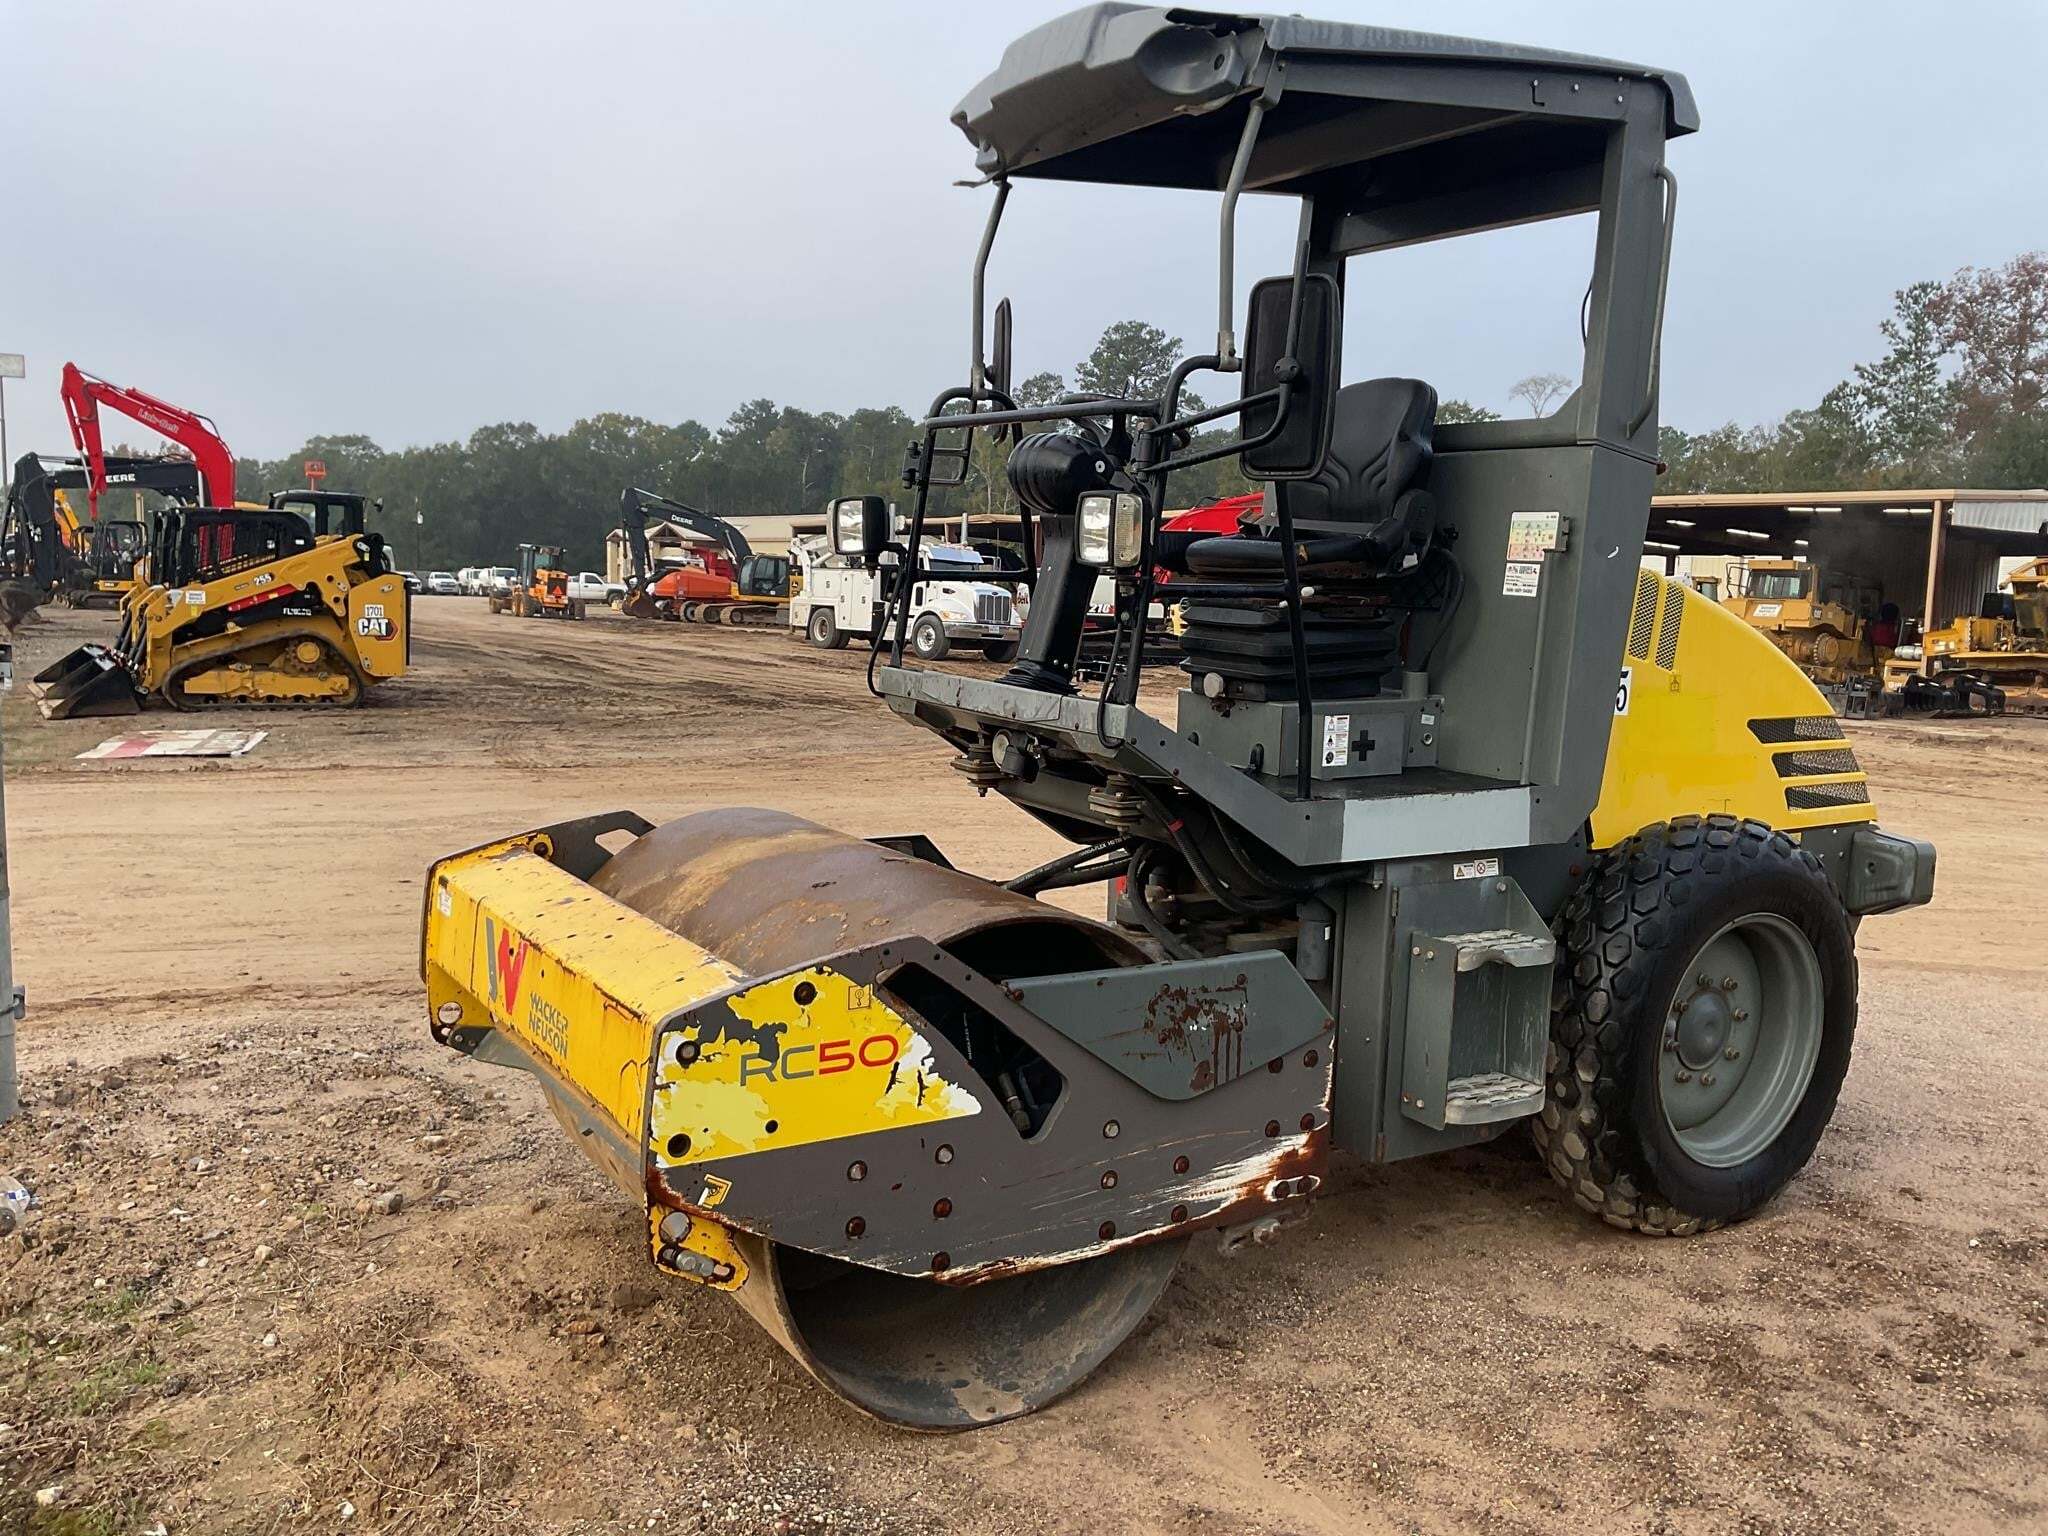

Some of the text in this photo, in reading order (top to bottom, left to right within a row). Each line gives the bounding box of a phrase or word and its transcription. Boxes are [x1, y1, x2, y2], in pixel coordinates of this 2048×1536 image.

[105, 473, 136, 483] EERE
[254, 573, 272, 585] 255
[366, 606, 383, 617] 1701
[357, 618, 390, 636] CAT
[530, 992, 569, 1034] WACKER
[739, 1033, 900, 1087] RC50
